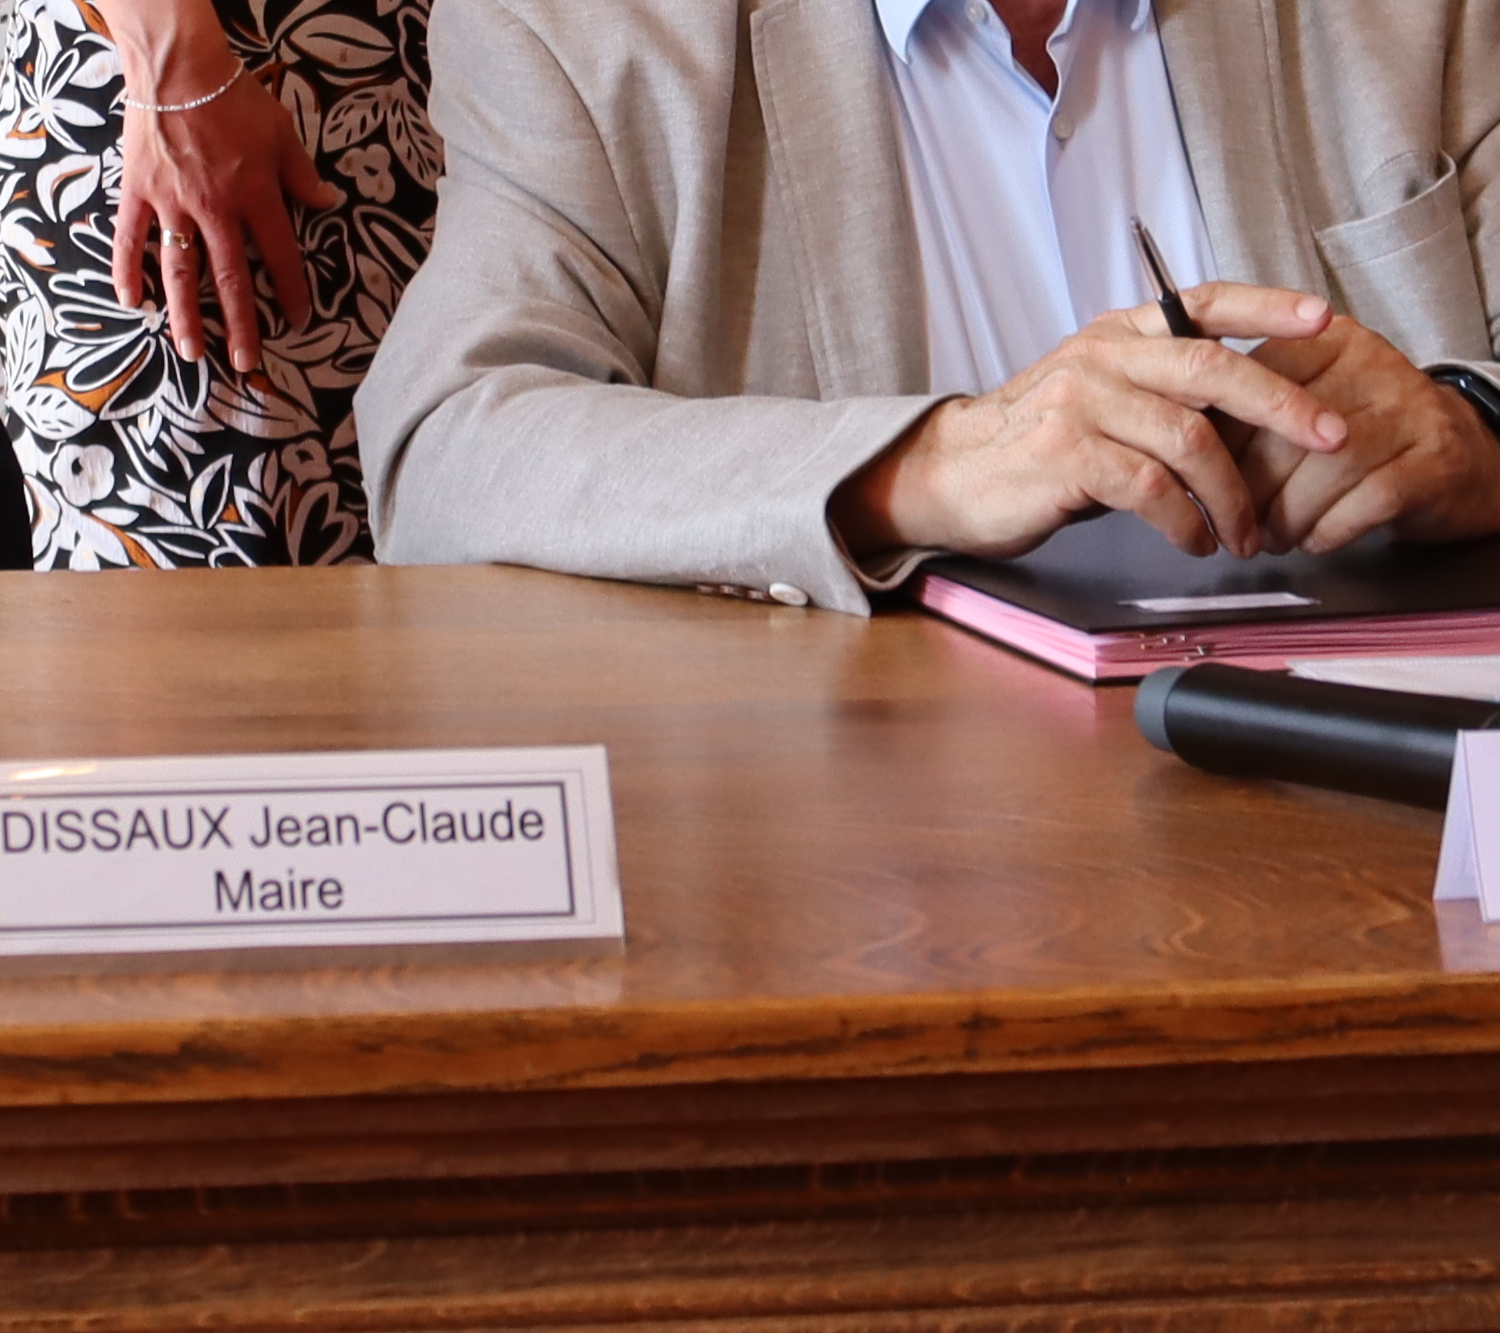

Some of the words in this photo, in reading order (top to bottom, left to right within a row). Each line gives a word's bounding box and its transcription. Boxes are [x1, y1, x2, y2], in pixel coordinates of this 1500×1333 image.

[0, 806, 235, 854] DISSAUX
[249, 800, 545, 849] Jean-Claude
[212, 867, 345, 914] Maire
